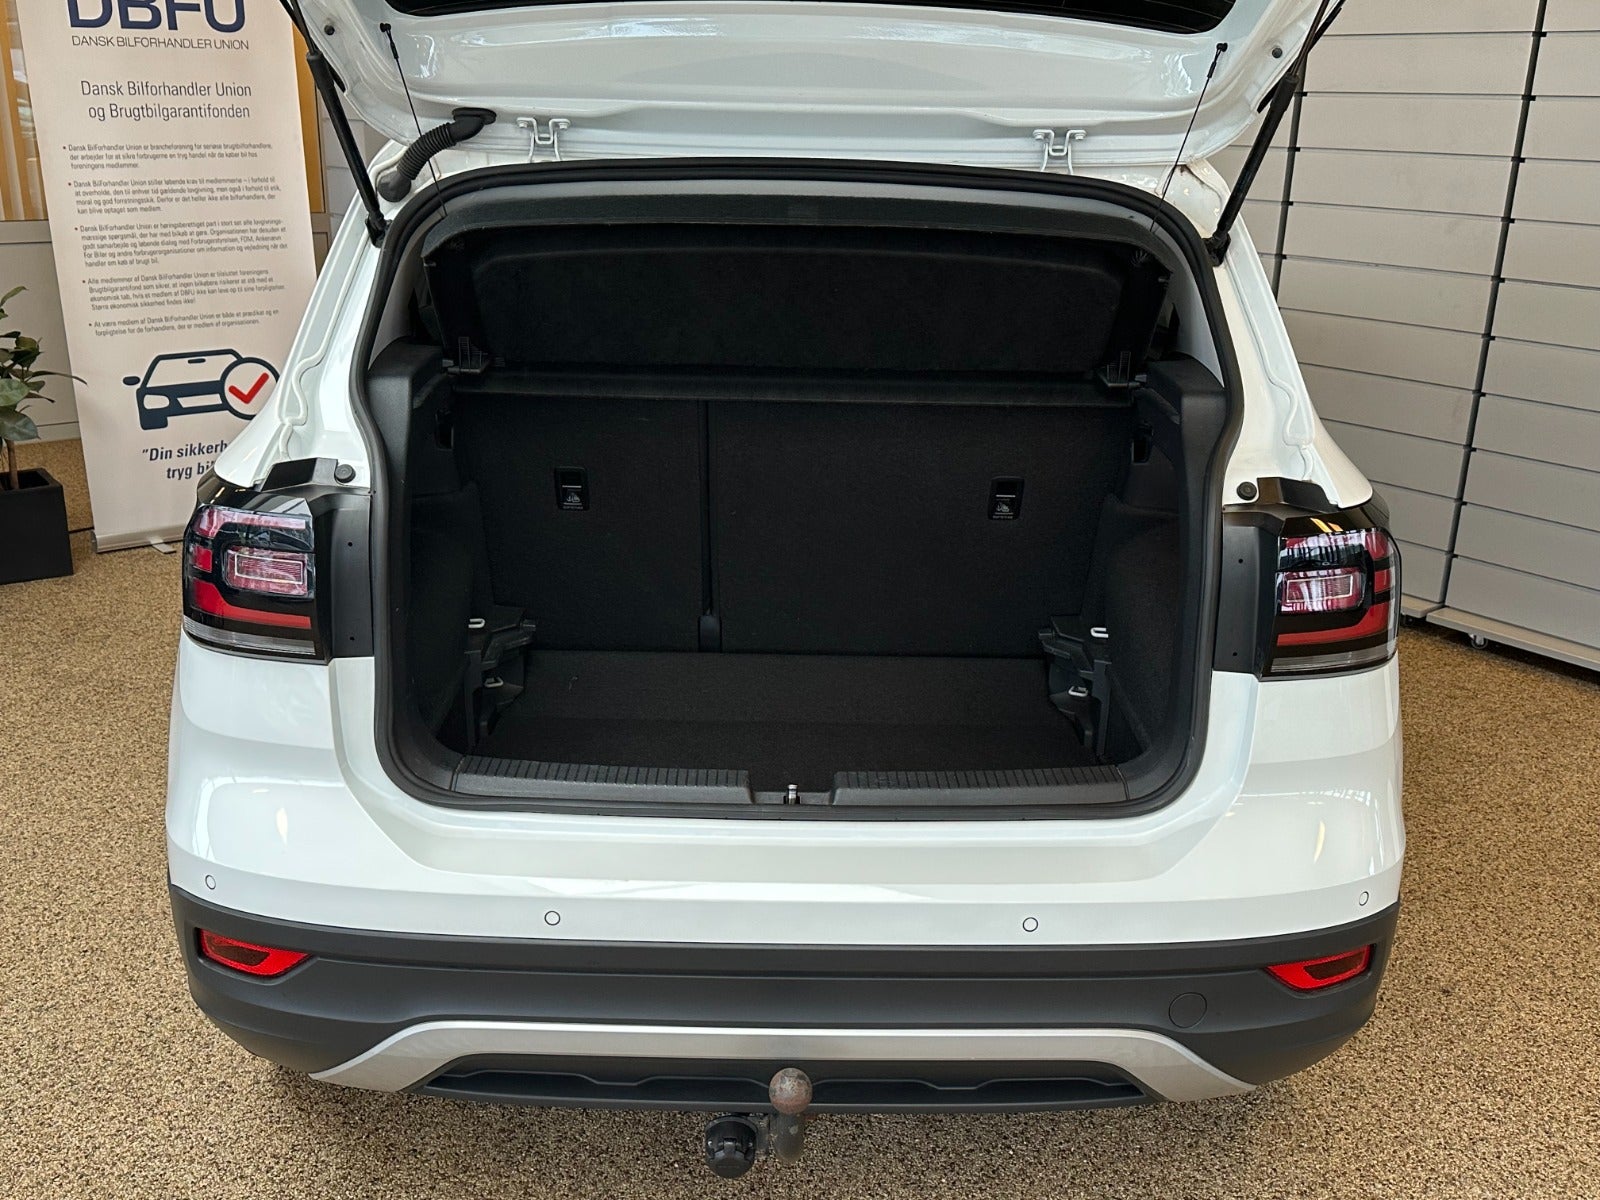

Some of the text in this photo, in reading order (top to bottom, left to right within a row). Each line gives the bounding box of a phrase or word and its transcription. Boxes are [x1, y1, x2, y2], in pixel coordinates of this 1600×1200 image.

[67, 0, 246, 32] DBFU
[72, 36, 249, 50] DANSK BILFORHANDLER UNION
[81, 80, 251, 97] Dansk Bilforhandler Union
[88, 103, 250, 121] og Brugtbilgarantifonden
[176, 440, 227, 458] sikkerh
[166, 467, 192, 480] tryg
